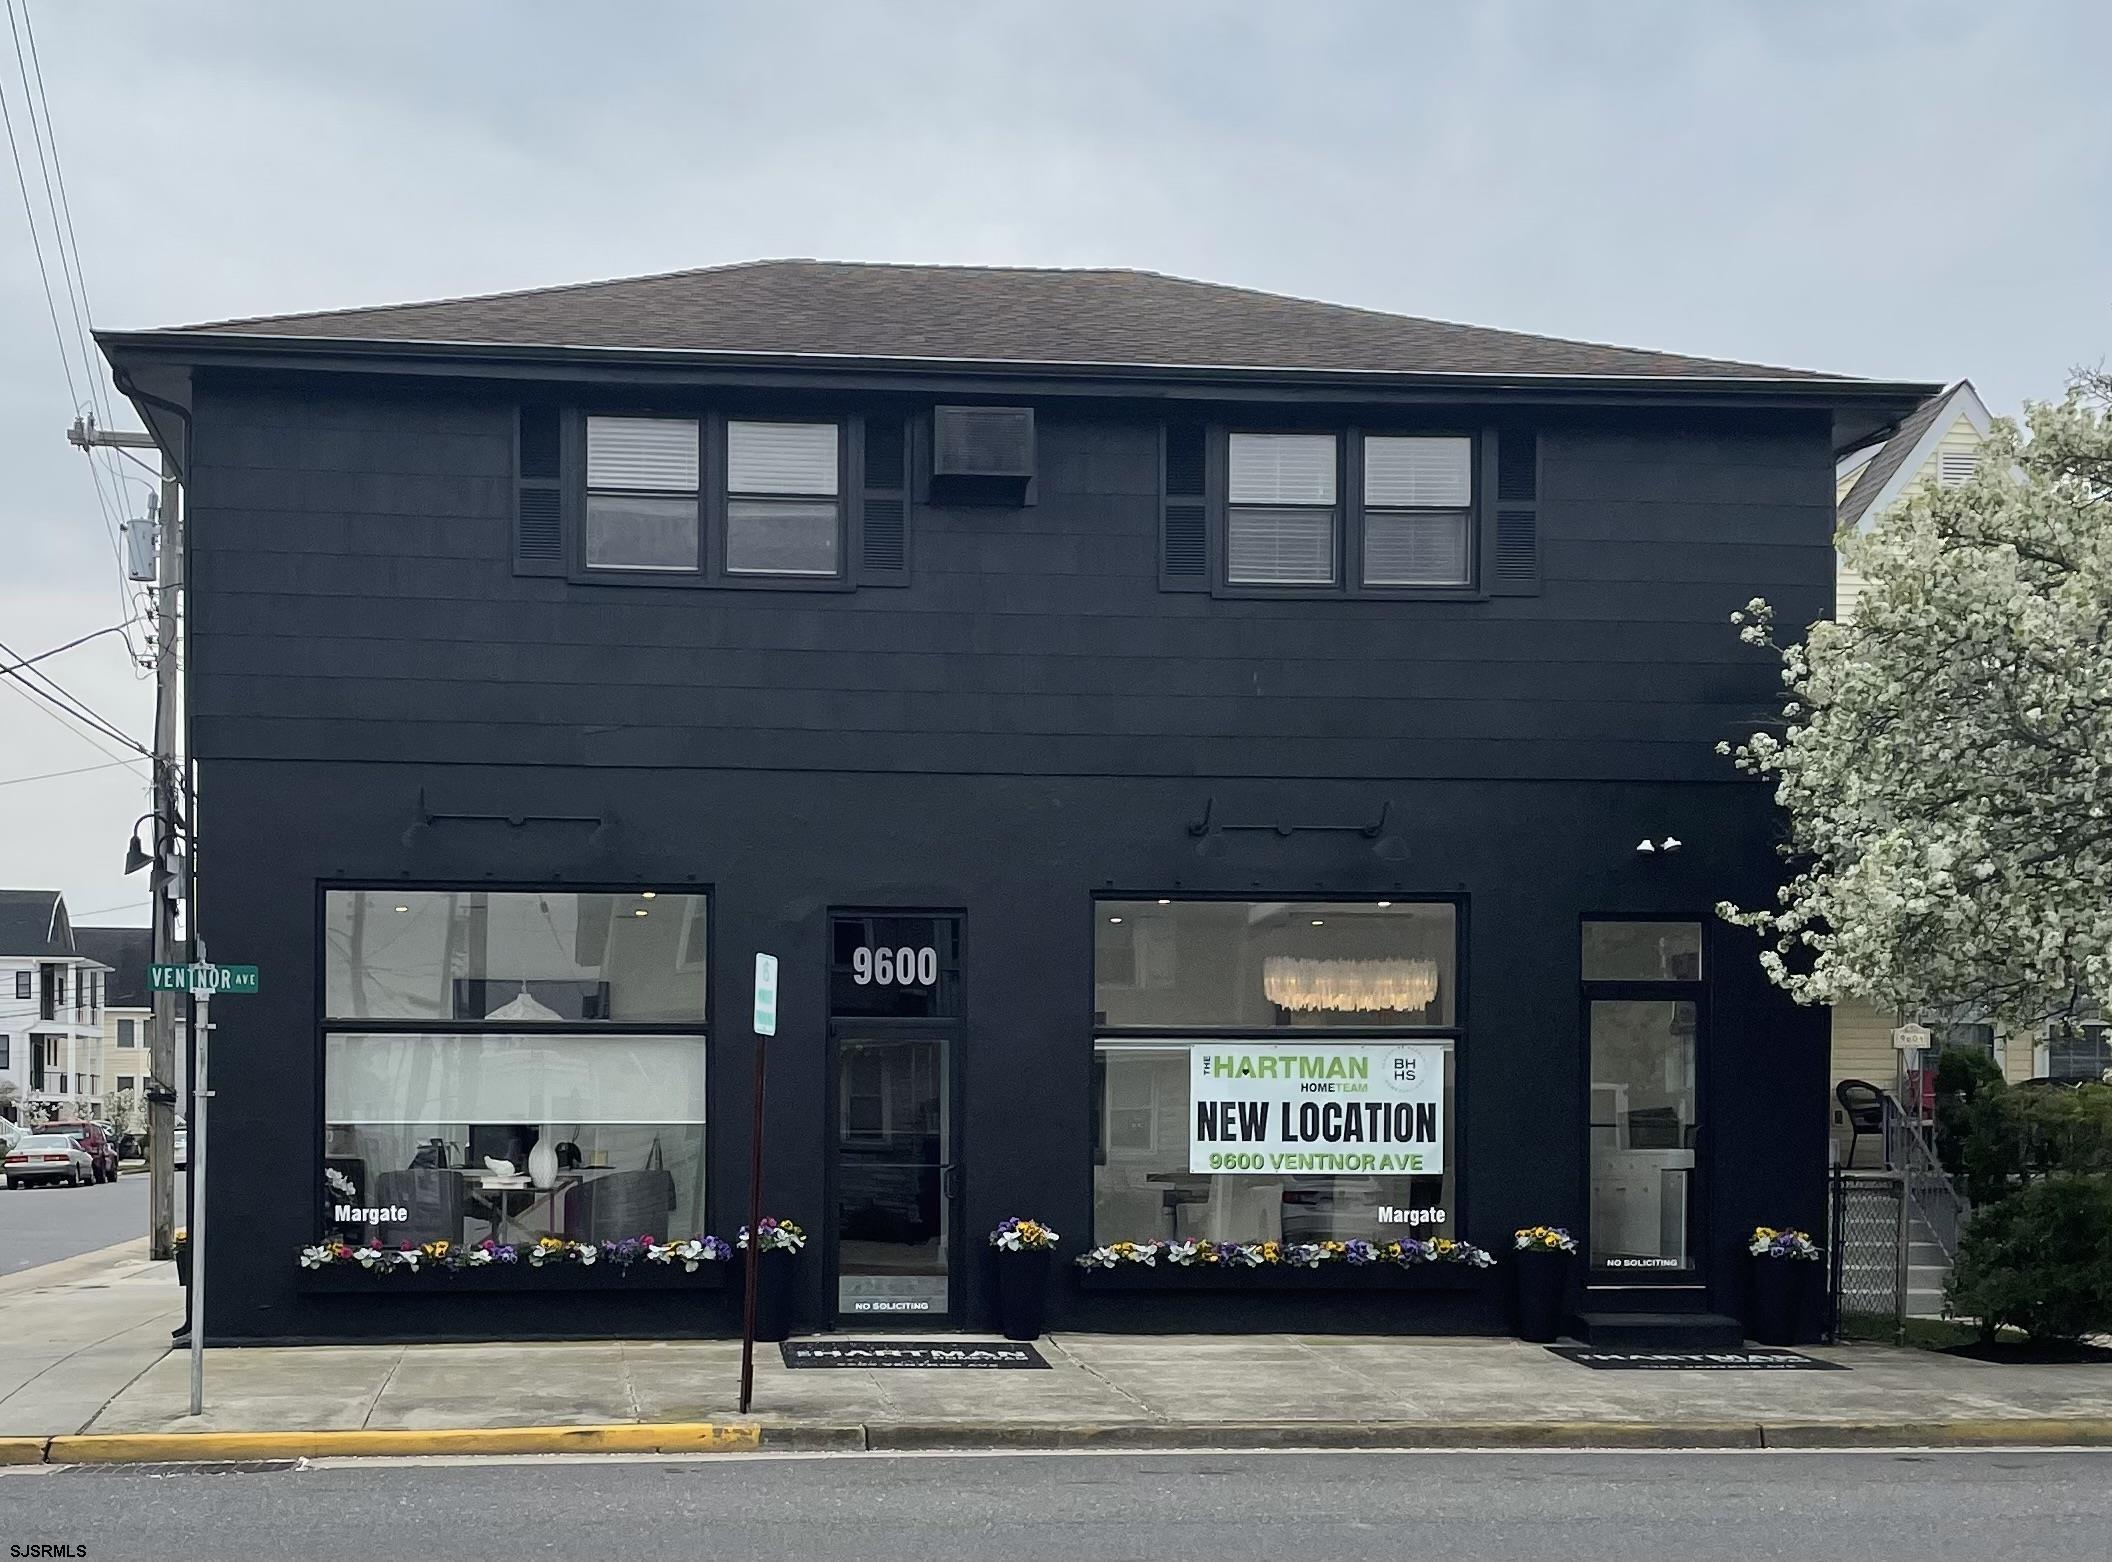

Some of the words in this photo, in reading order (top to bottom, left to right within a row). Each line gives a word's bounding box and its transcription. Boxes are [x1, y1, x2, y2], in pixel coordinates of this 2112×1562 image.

[853, 946, 937, 986] 9600
[152, 967, 231, 989] VENTNOR
[235, 973, 256, 986] AVE
[1203, 1055, 1211, 1076] THE
[1213, 1055, 1369, 1080] HARTMAN
[1394, 1058, 1416, 1069] BH
[1394, 1070, 1416, 1081] HS
[1300, 1082, 1369, 1093] HOMETEAM
[1197, 1101, 1270, 1143] NEW
[1281, 1101, 1437, 1144] LOCATION
[1208, 1152, 1265, 1171] 9600
[1269, 1152, 1376, 1172] VENTNOR
[1379, 1153, 1424, 1171] AVE
[335, 1204, 408, 1225] Margate
[1378, 1206, 1447, 1227] Margate
[1606, 1259, 1622, 1267] NO
[1623, 1259, 1678, 1267] SOLICITING
[855, 1302, 871, 1311] NO
[872, 1302, 929, 1311] SOLICITING
